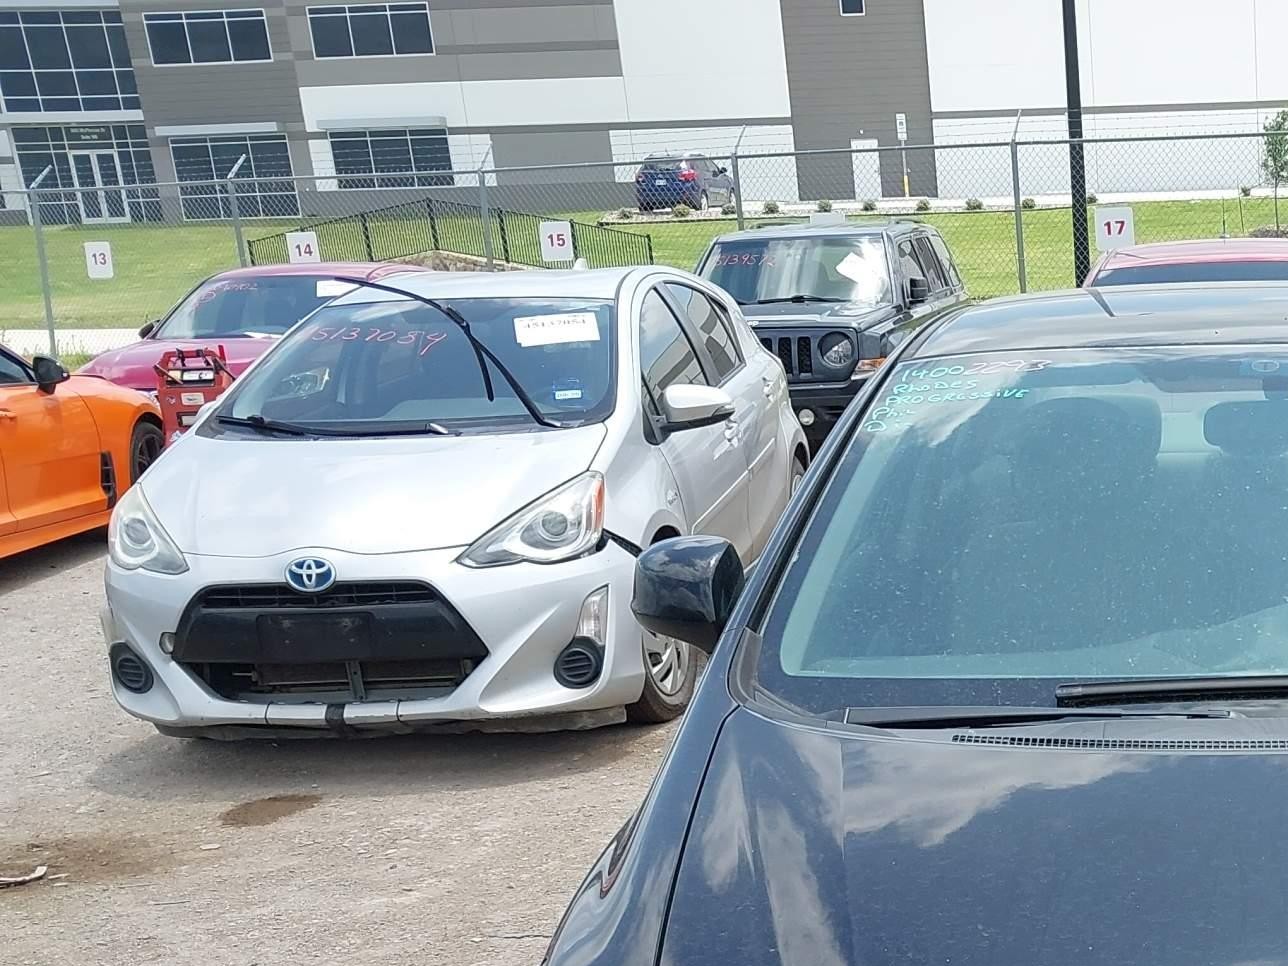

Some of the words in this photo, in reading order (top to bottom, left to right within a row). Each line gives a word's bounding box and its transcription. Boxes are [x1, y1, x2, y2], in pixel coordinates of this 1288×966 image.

[1103, 220, 1126, 236] 17
[547, 233, 566, 247] 15
[295, 243, 314, 257] 14
[91, 252, 108, 266] 13
